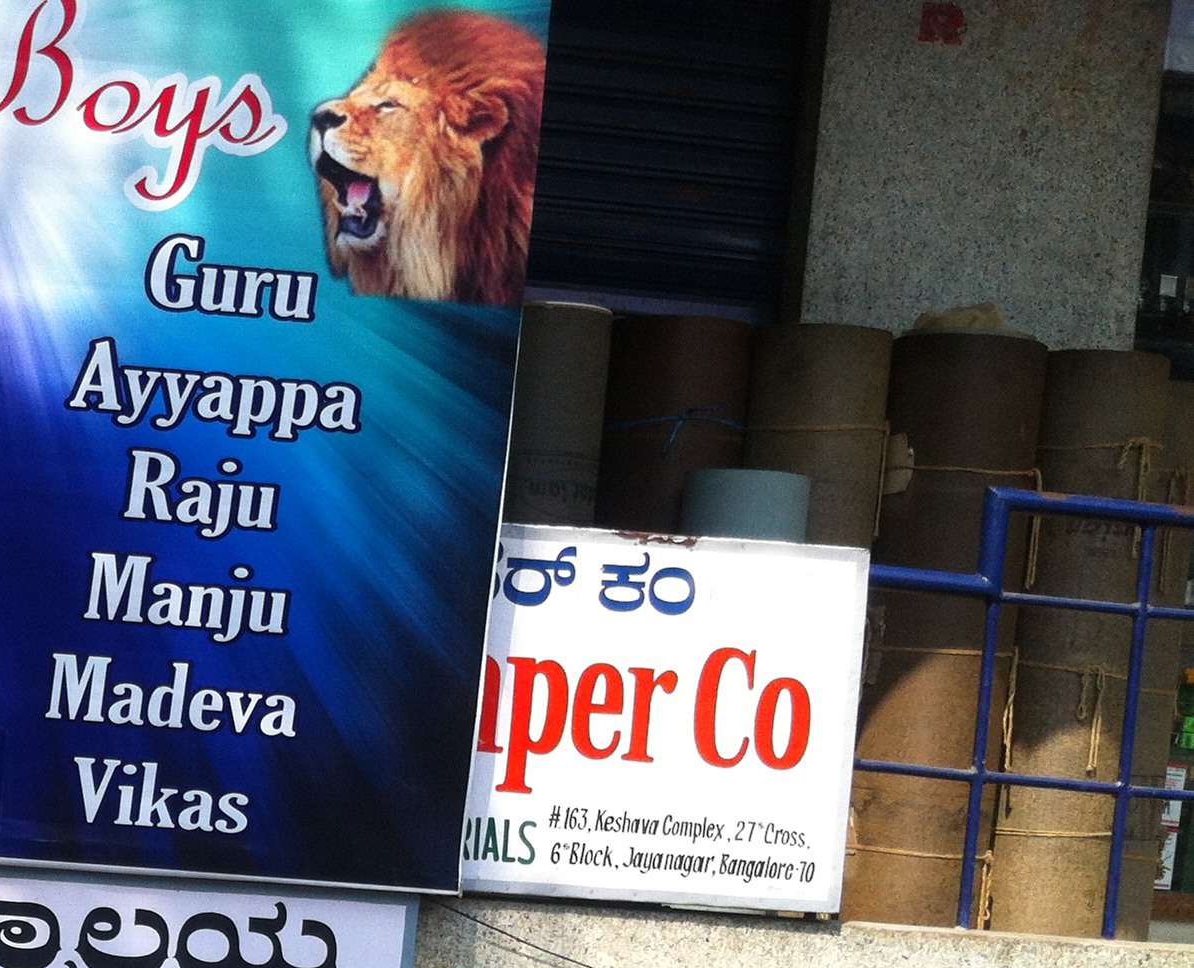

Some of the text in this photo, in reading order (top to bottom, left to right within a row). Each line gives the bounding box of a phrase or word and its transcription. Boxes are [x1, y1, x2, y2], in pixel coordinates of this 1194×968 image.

[150, 235, 313, 319] Guru
[69, 340, 356, 439] Ayyappa
[123, 449, 275, 538] Raju
[83, 552, 286, 642] Manju
[492, 541, 695, 616] ರ್ ಕಂ
[45, 653, 296, 737] Madeva
[694, 646, 811, 770] Co
[74, 756, 249, 834] Vikas
[594, 809, 659, 836] Keshava
[622, 846, 716, 878] Jayanagar,
